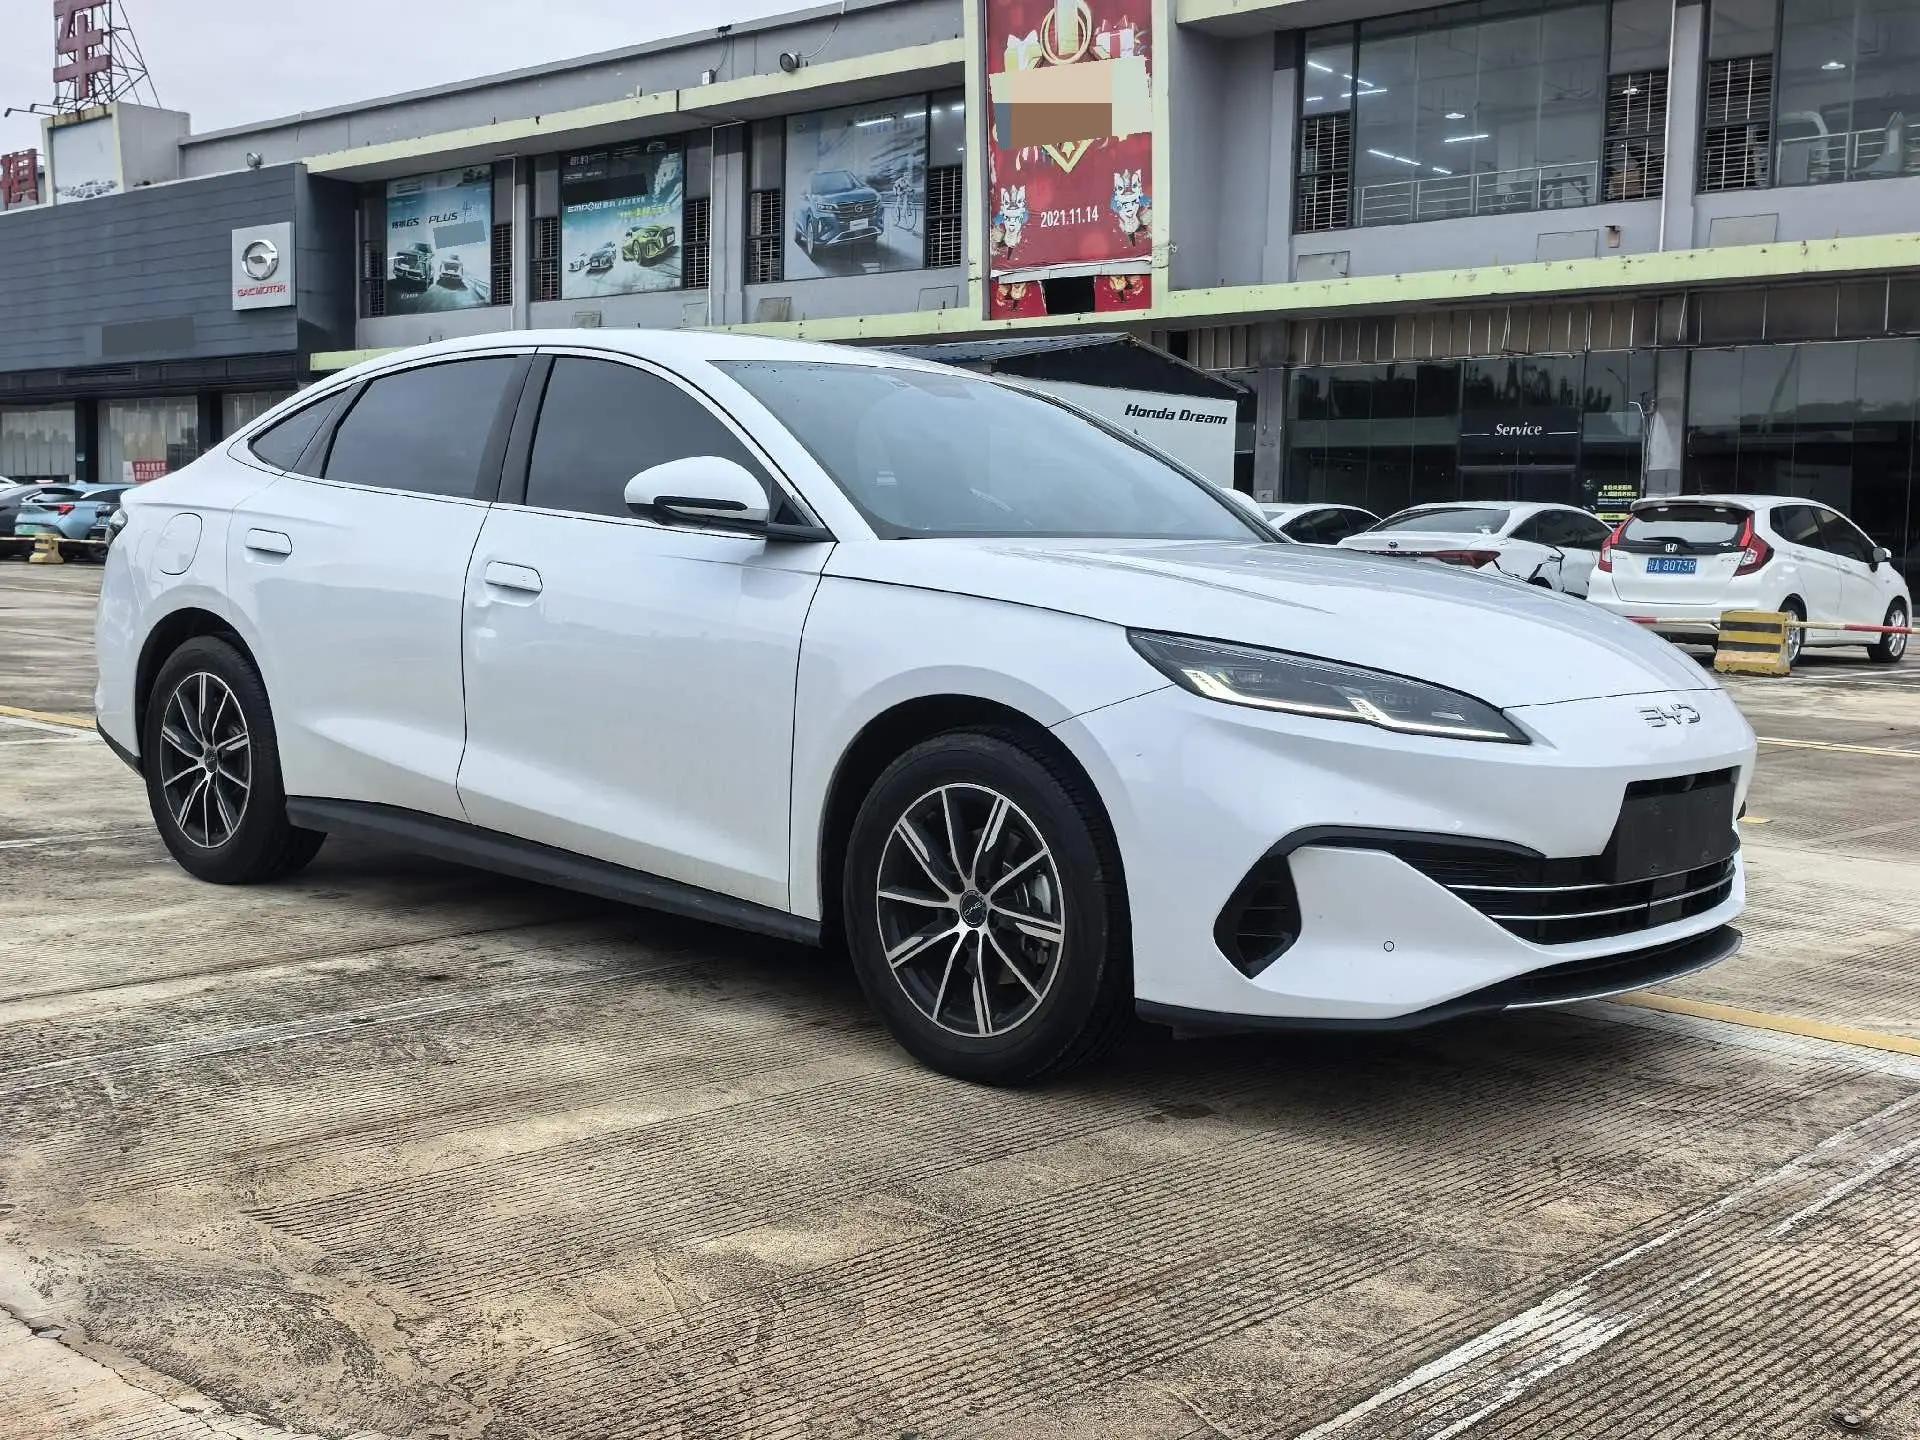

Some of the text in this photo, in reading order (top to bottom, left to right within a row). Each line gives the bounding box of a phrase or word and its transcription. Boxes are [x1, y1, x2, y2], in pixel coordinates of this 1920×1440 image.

[53, 0, 112, 99] 车
[429, 212, 458, 224] PLUS
[1040, 205, 1099, 228] 2021.11.14
[1124, 403, 1228, 424] Honda Dream
[1494, 421, 1543, 436] Service
